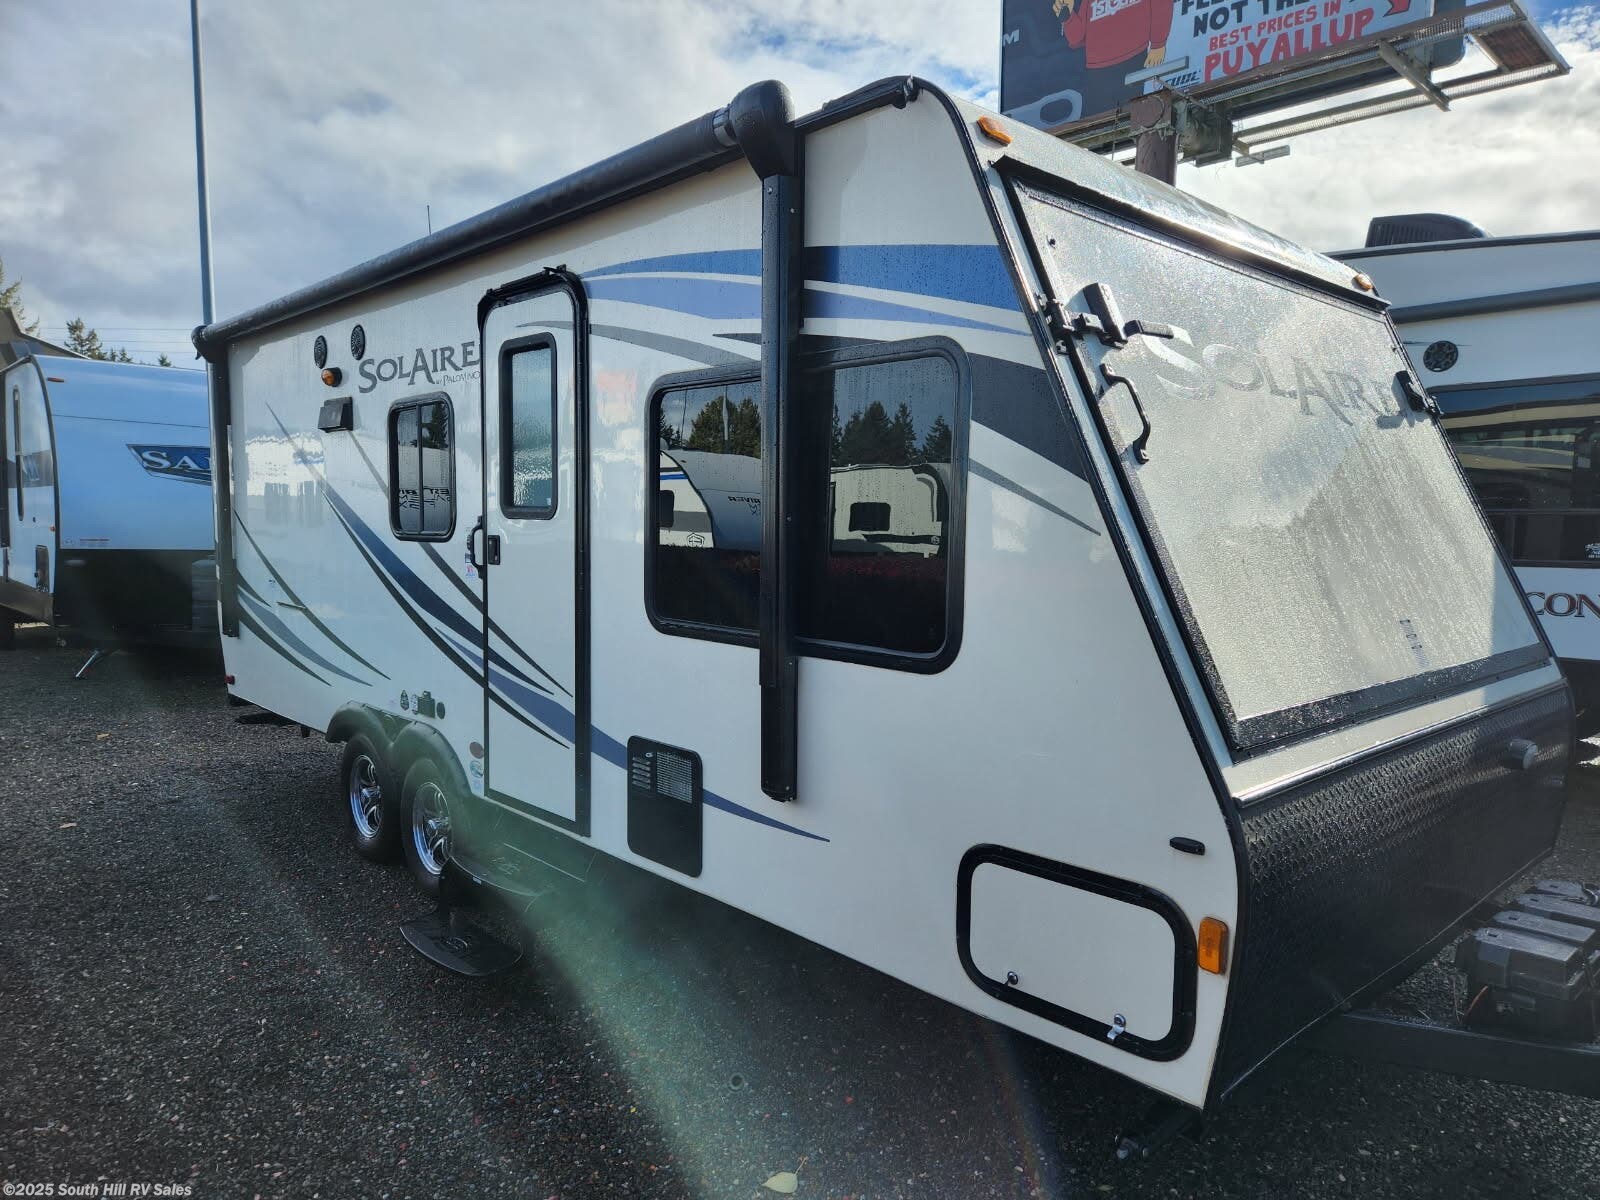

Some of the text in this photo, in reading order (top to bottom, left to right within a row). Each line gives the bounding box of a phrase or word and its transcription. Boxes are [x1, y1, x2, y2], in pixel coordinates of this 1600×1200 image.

[1193, 1, 1248, 37] NOT
[1204, 7, 1374, 82] PUYALLUP
[1209, 0, 1342, 51] BEST PRICES IN
[359, 341, 480, 393] SOLAIRE
[141, 450, 211, 470] SA
